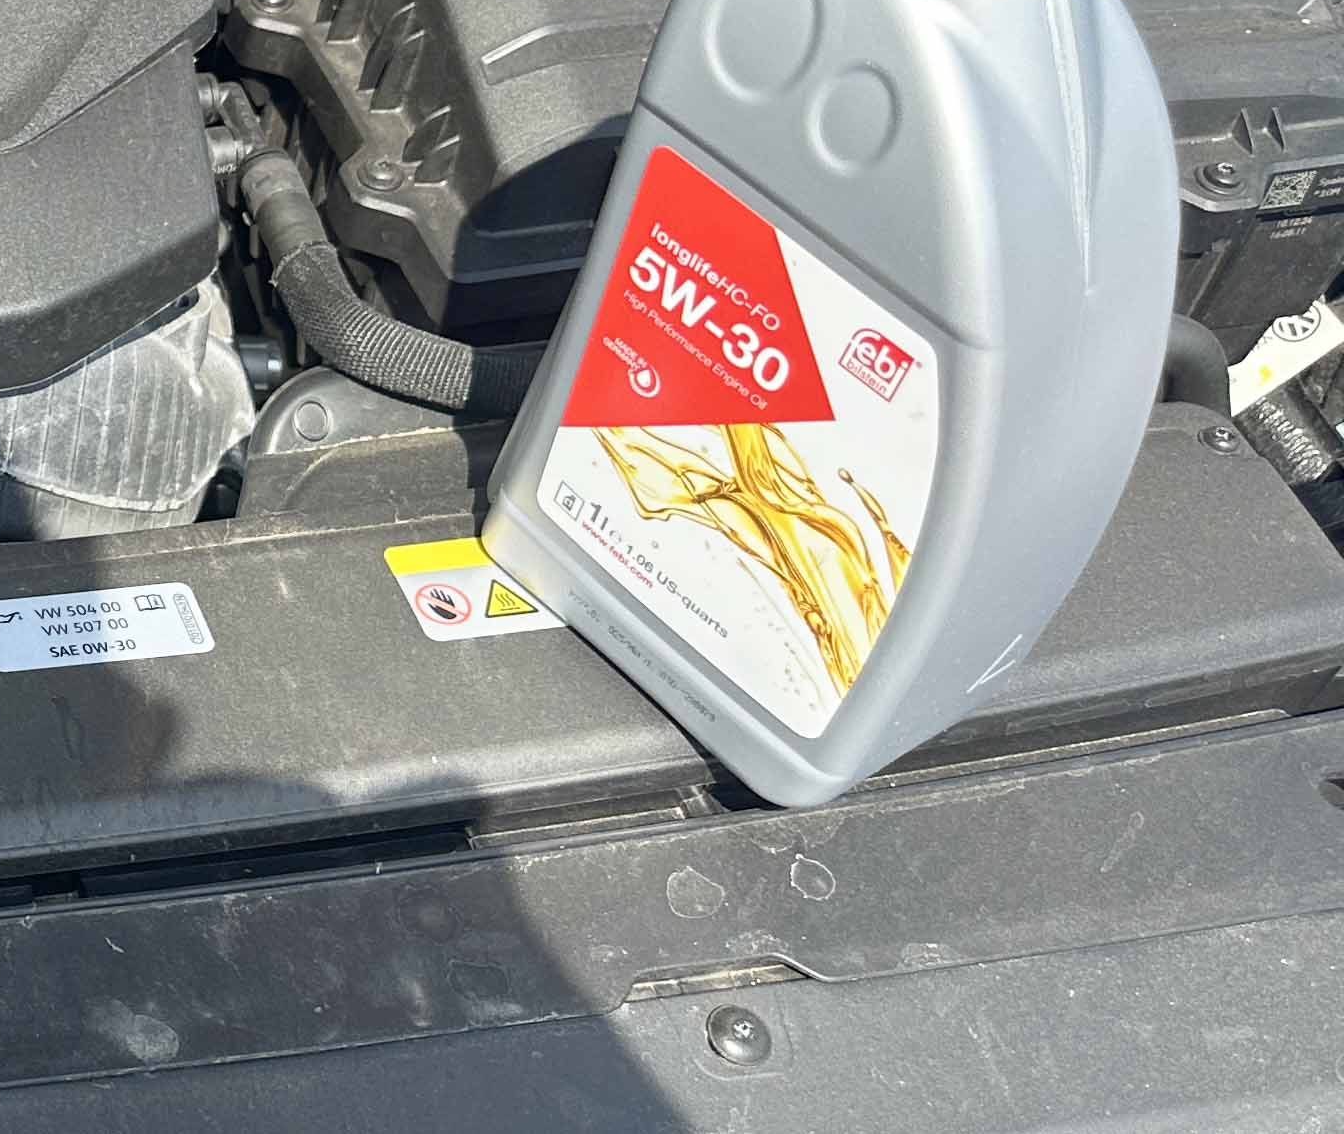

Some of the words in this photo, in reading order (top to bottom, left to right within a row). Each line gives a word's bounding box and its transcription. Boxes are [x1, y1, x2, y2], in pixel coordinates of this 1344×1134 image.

[629, 246, 790, 392] 5W-30
[624, 290, 648, 314] High
[648, 310, 712, 367] Performance
[712, 362, 750, 398] Engine
[750, 393, 768, 411] Oil
[842, 328, 912, 391] febi
[846, 357, 888, 395] bilstein
[34, 606, 64, 621] VW
[66, 603, 98, 618] 504
[100, 601, 122, 615] 00
[626, 545, 654, 572] 1.06
[656, 570, 729, 638] US-quarts
[41, 622, 72, 638] VW
[73, 619, 105, 635] 507
[107, 617, 129, 632] 00
[49, 642, 80, 659] SAE
[82, 638, 137, 657] 0W-30
